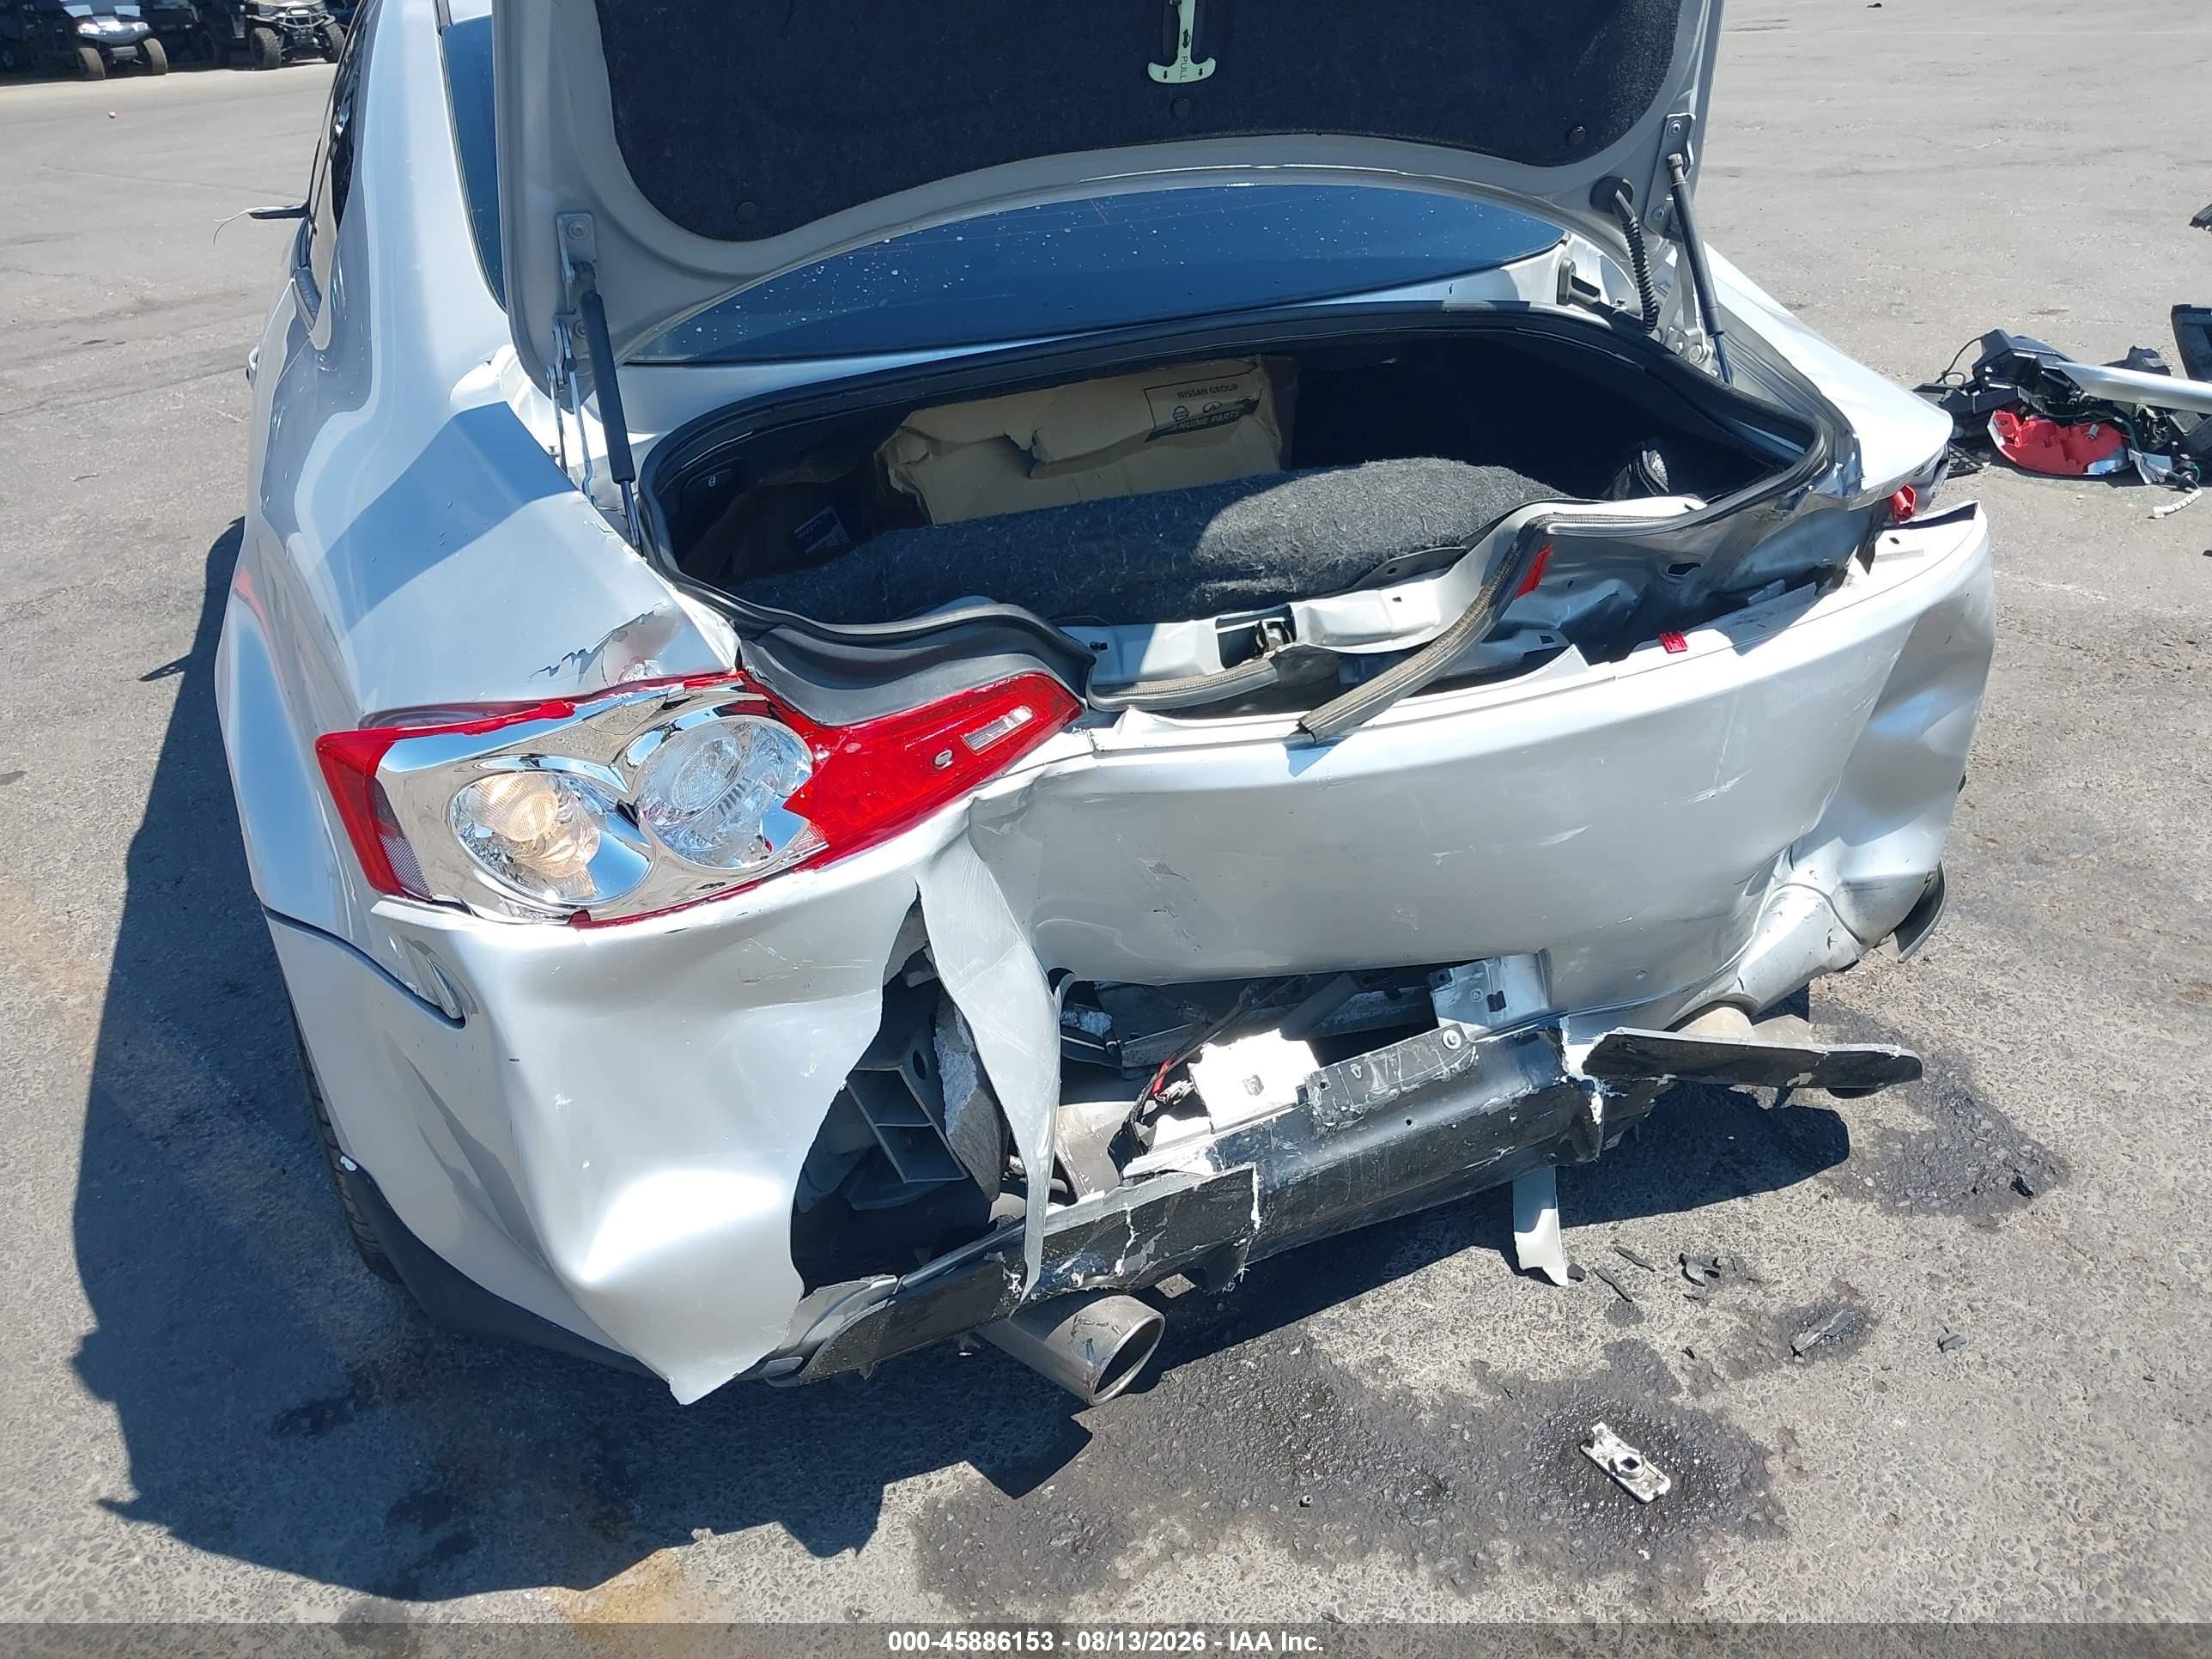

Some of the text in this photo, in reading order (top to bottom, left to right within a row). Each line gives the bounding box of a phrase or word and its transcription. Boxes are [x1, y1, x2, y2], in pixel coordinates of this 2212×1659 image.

[1179, 56, 1188, 82] PULL
[1176, 383, 1238, 398] NISSAN GROUP
[1211, 411, 1240, 424] PARTS
